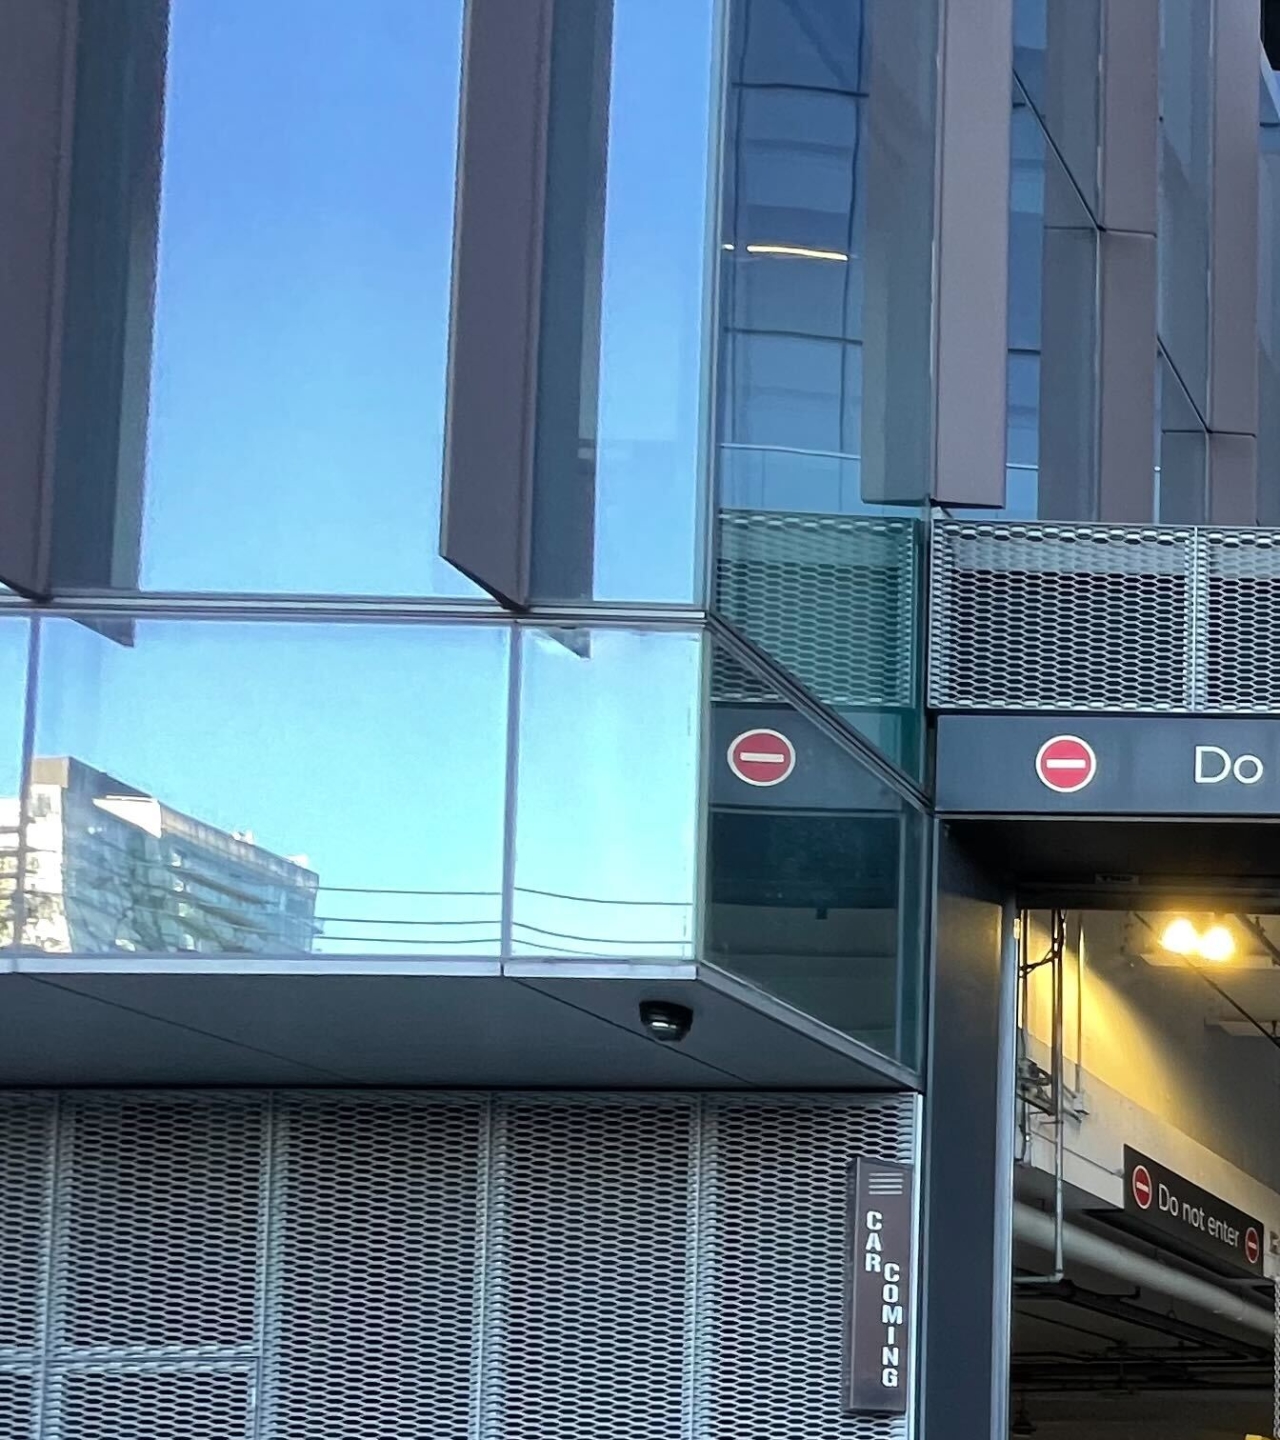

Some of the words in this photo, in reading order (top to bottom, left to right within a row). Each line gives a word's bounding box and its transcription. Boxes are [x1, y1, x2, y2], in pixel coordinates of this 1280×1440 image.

[1194, 745, 1264, 785] Do
[1158, 1183, 1179, 1217] Do
[1182, 1202, 1206, 1231] not
[1207, 1216, 1240, 1248] enter
[865, 1210, 883, 1273] CAR
[881, 1262, 903, 1388] COMING
